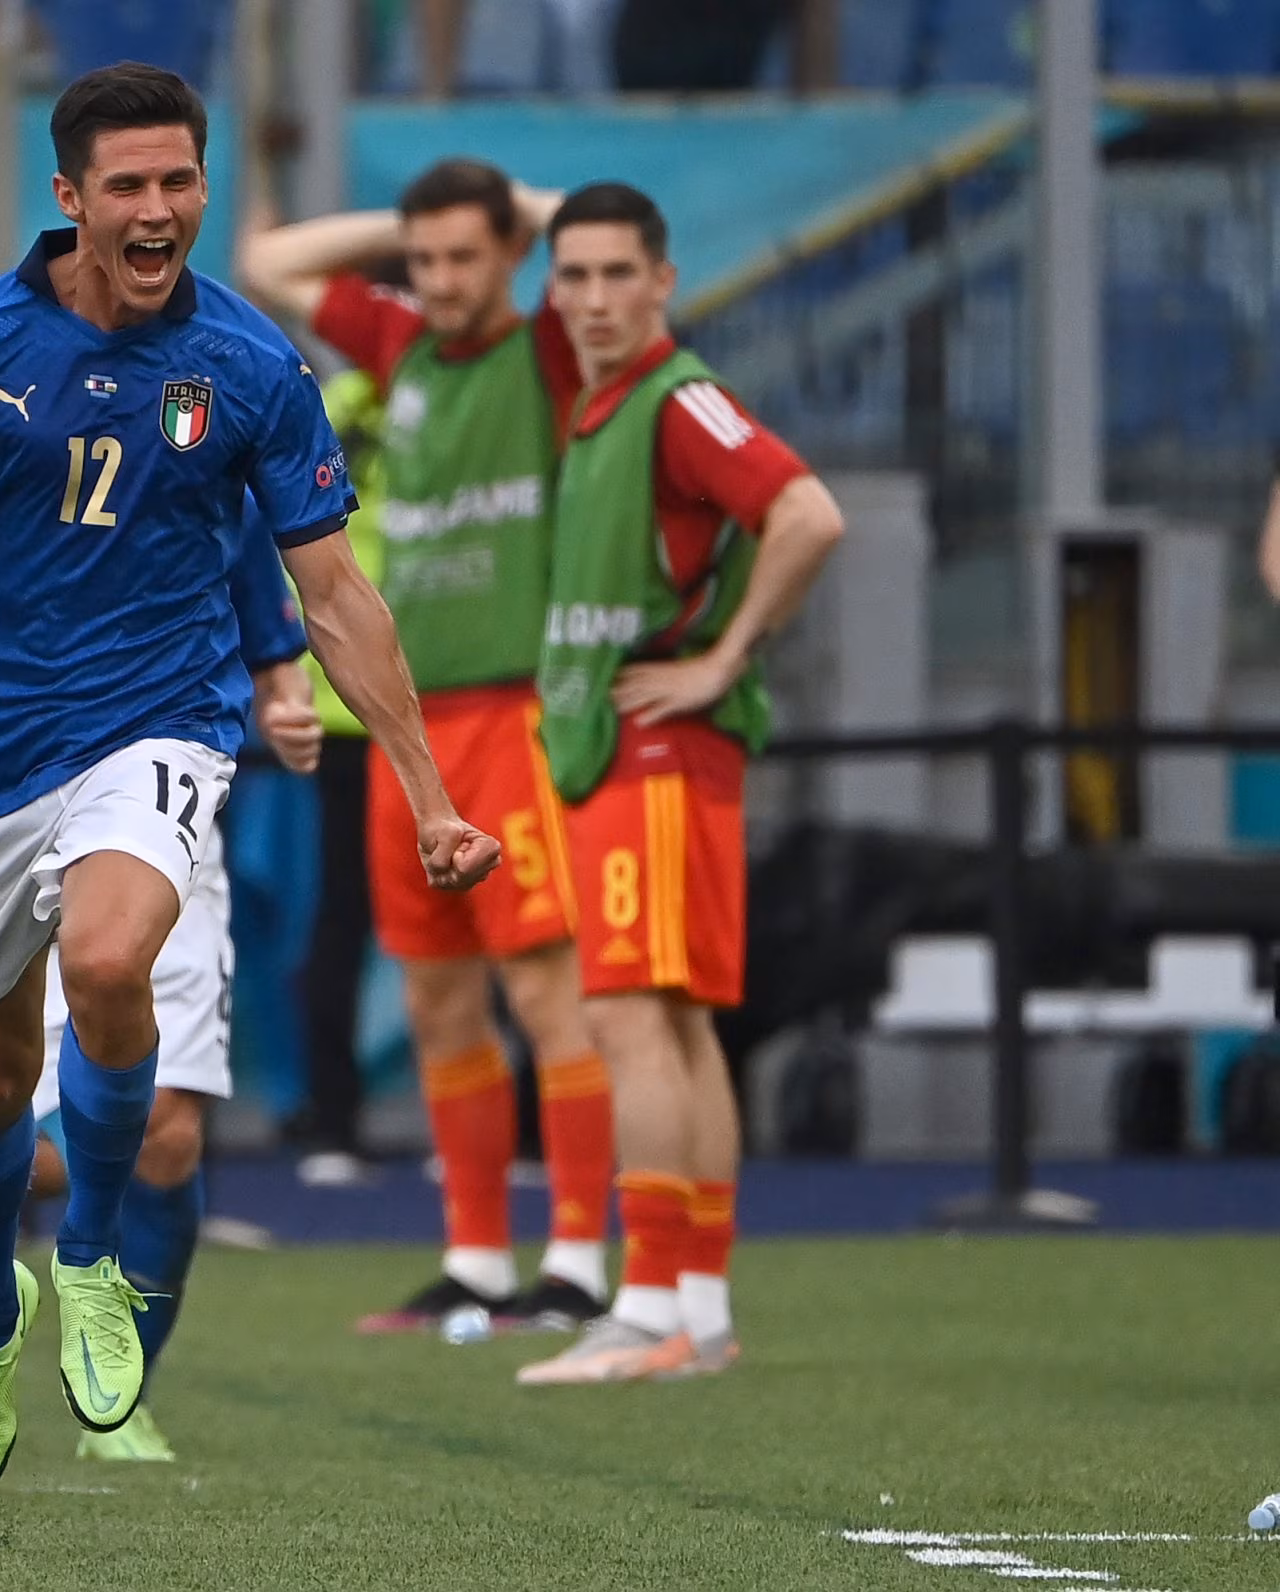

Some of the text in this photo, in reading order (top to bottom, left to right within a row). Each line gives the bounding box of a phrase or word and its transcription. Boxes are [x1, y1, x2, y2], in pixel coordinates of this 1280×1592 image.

[167, 386, 208, 400] ITALIA
[59, 436, 123, 527] 12
[152, 760, 199, 842] 12
[502, 809, 548, 889] 5
[602, 847, 641, 929] 8
